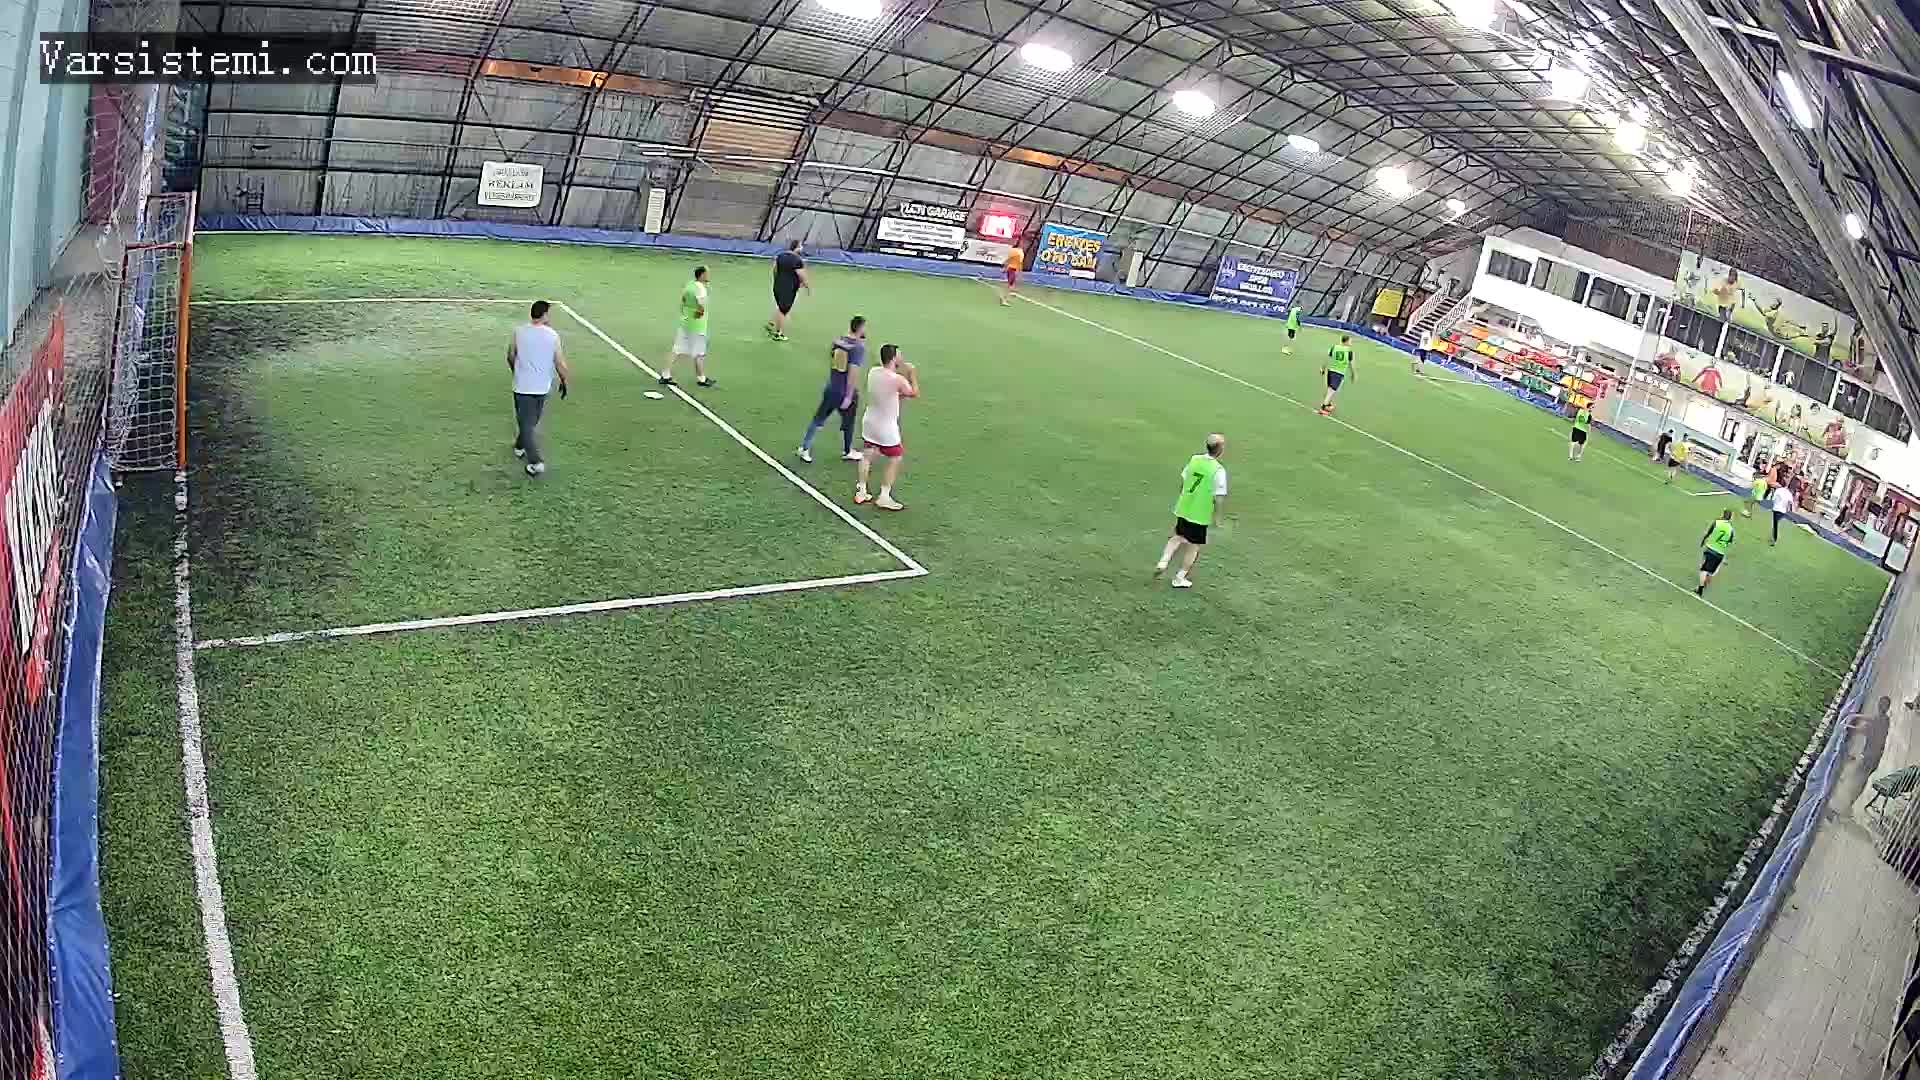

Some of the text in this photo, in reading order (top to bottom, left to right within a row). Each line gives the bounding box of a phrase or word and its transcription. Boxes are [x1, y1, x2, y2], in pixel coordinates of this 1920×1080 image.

[926, 205, 969, 222] GARAGE
[1189, 471, 1205, 494] 7
[1715, 530, 1729, 544] 2
